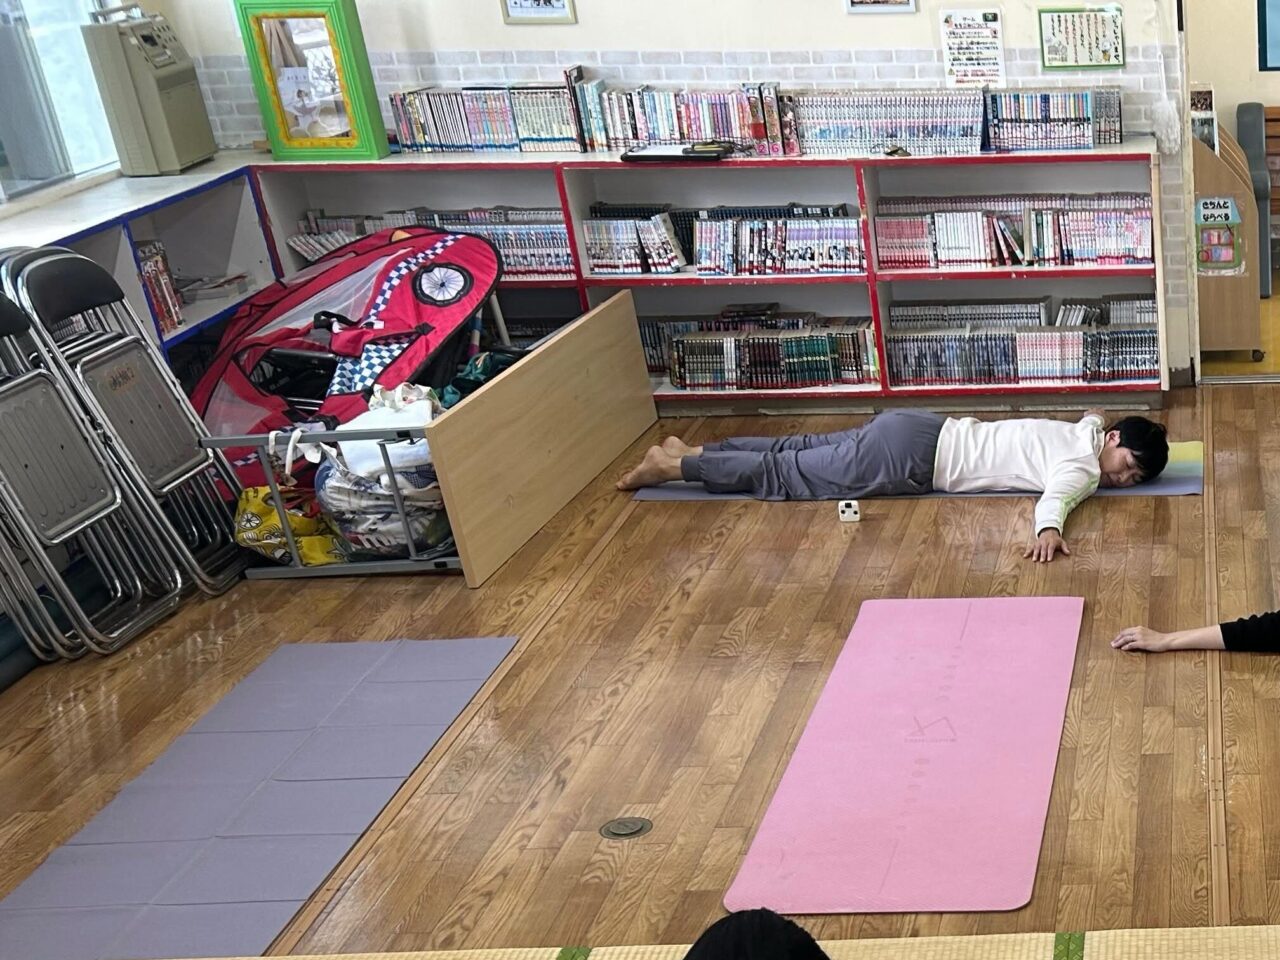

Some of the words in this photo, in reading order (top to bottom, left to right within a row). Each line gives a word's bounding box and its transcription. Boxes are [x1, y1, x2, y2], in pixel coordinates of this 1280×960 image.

[1202, 200, 1230, 210] きちんと
[1202, 212, 1230, 222] ならべる
